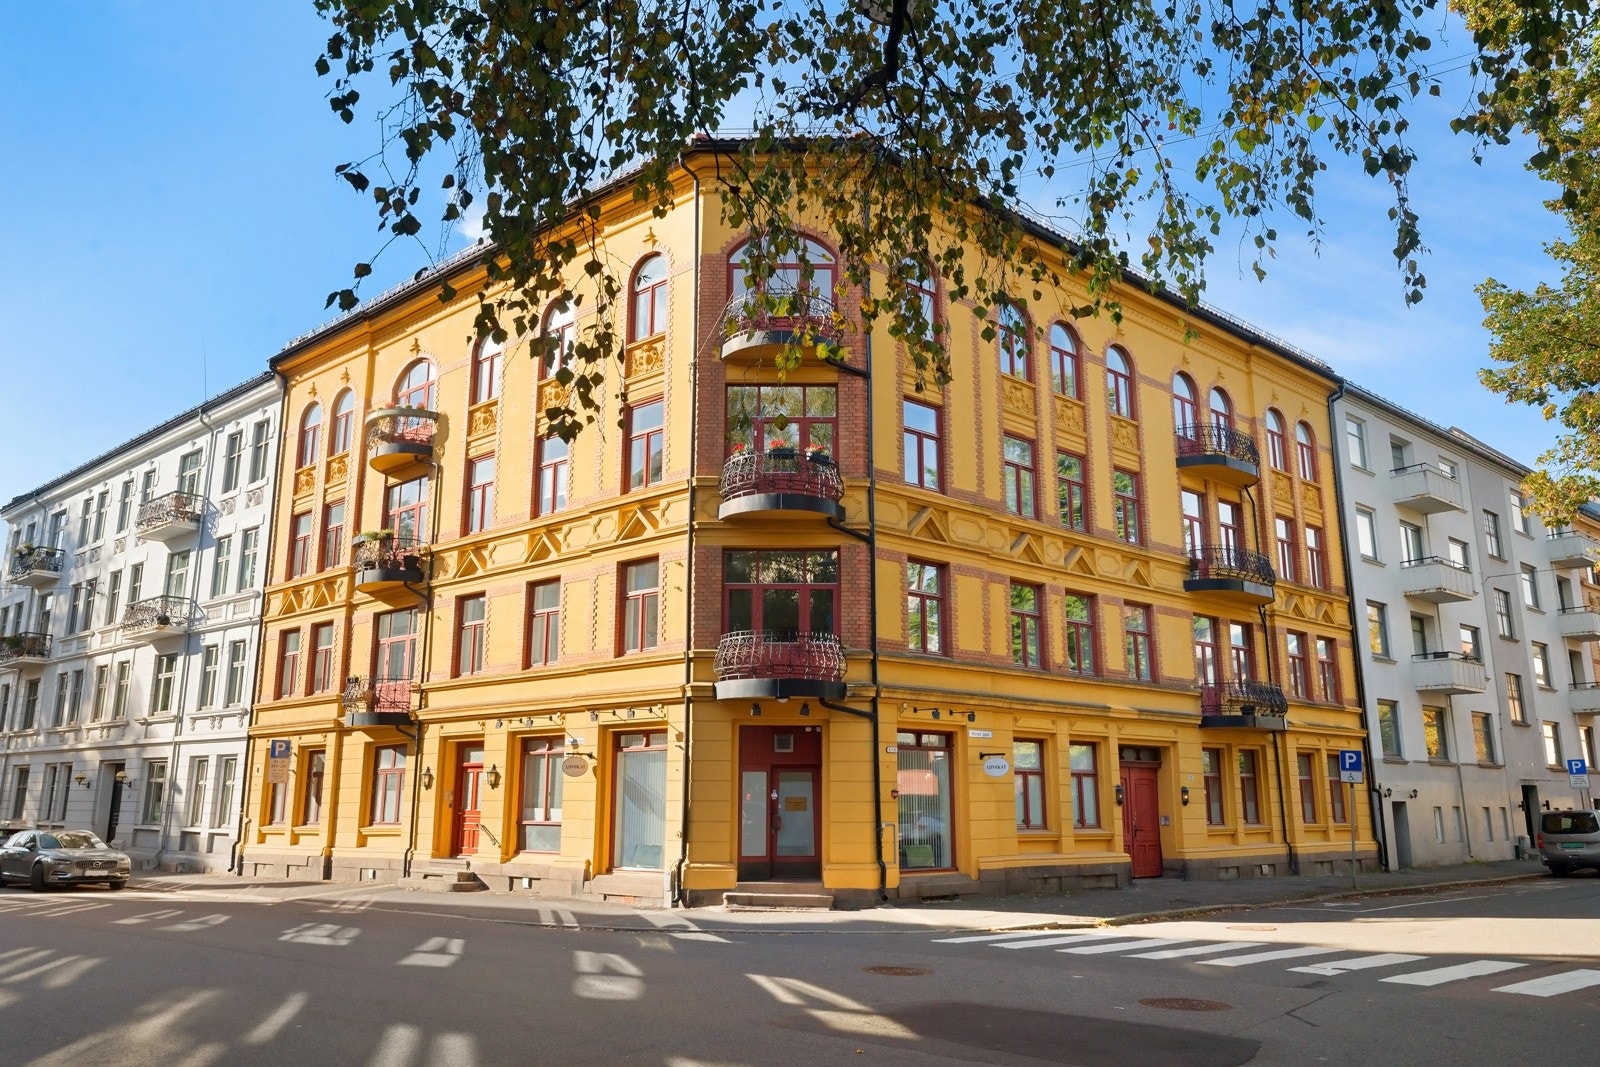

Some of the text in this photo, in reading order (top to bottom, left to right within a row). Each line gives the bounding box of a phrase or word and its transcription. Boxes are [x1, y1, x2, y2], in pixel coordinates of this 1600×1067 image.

[275, 742, 286, 756] P
[1345, 752, 1357, 769] P
[1571, 761, 1582, 773] P
